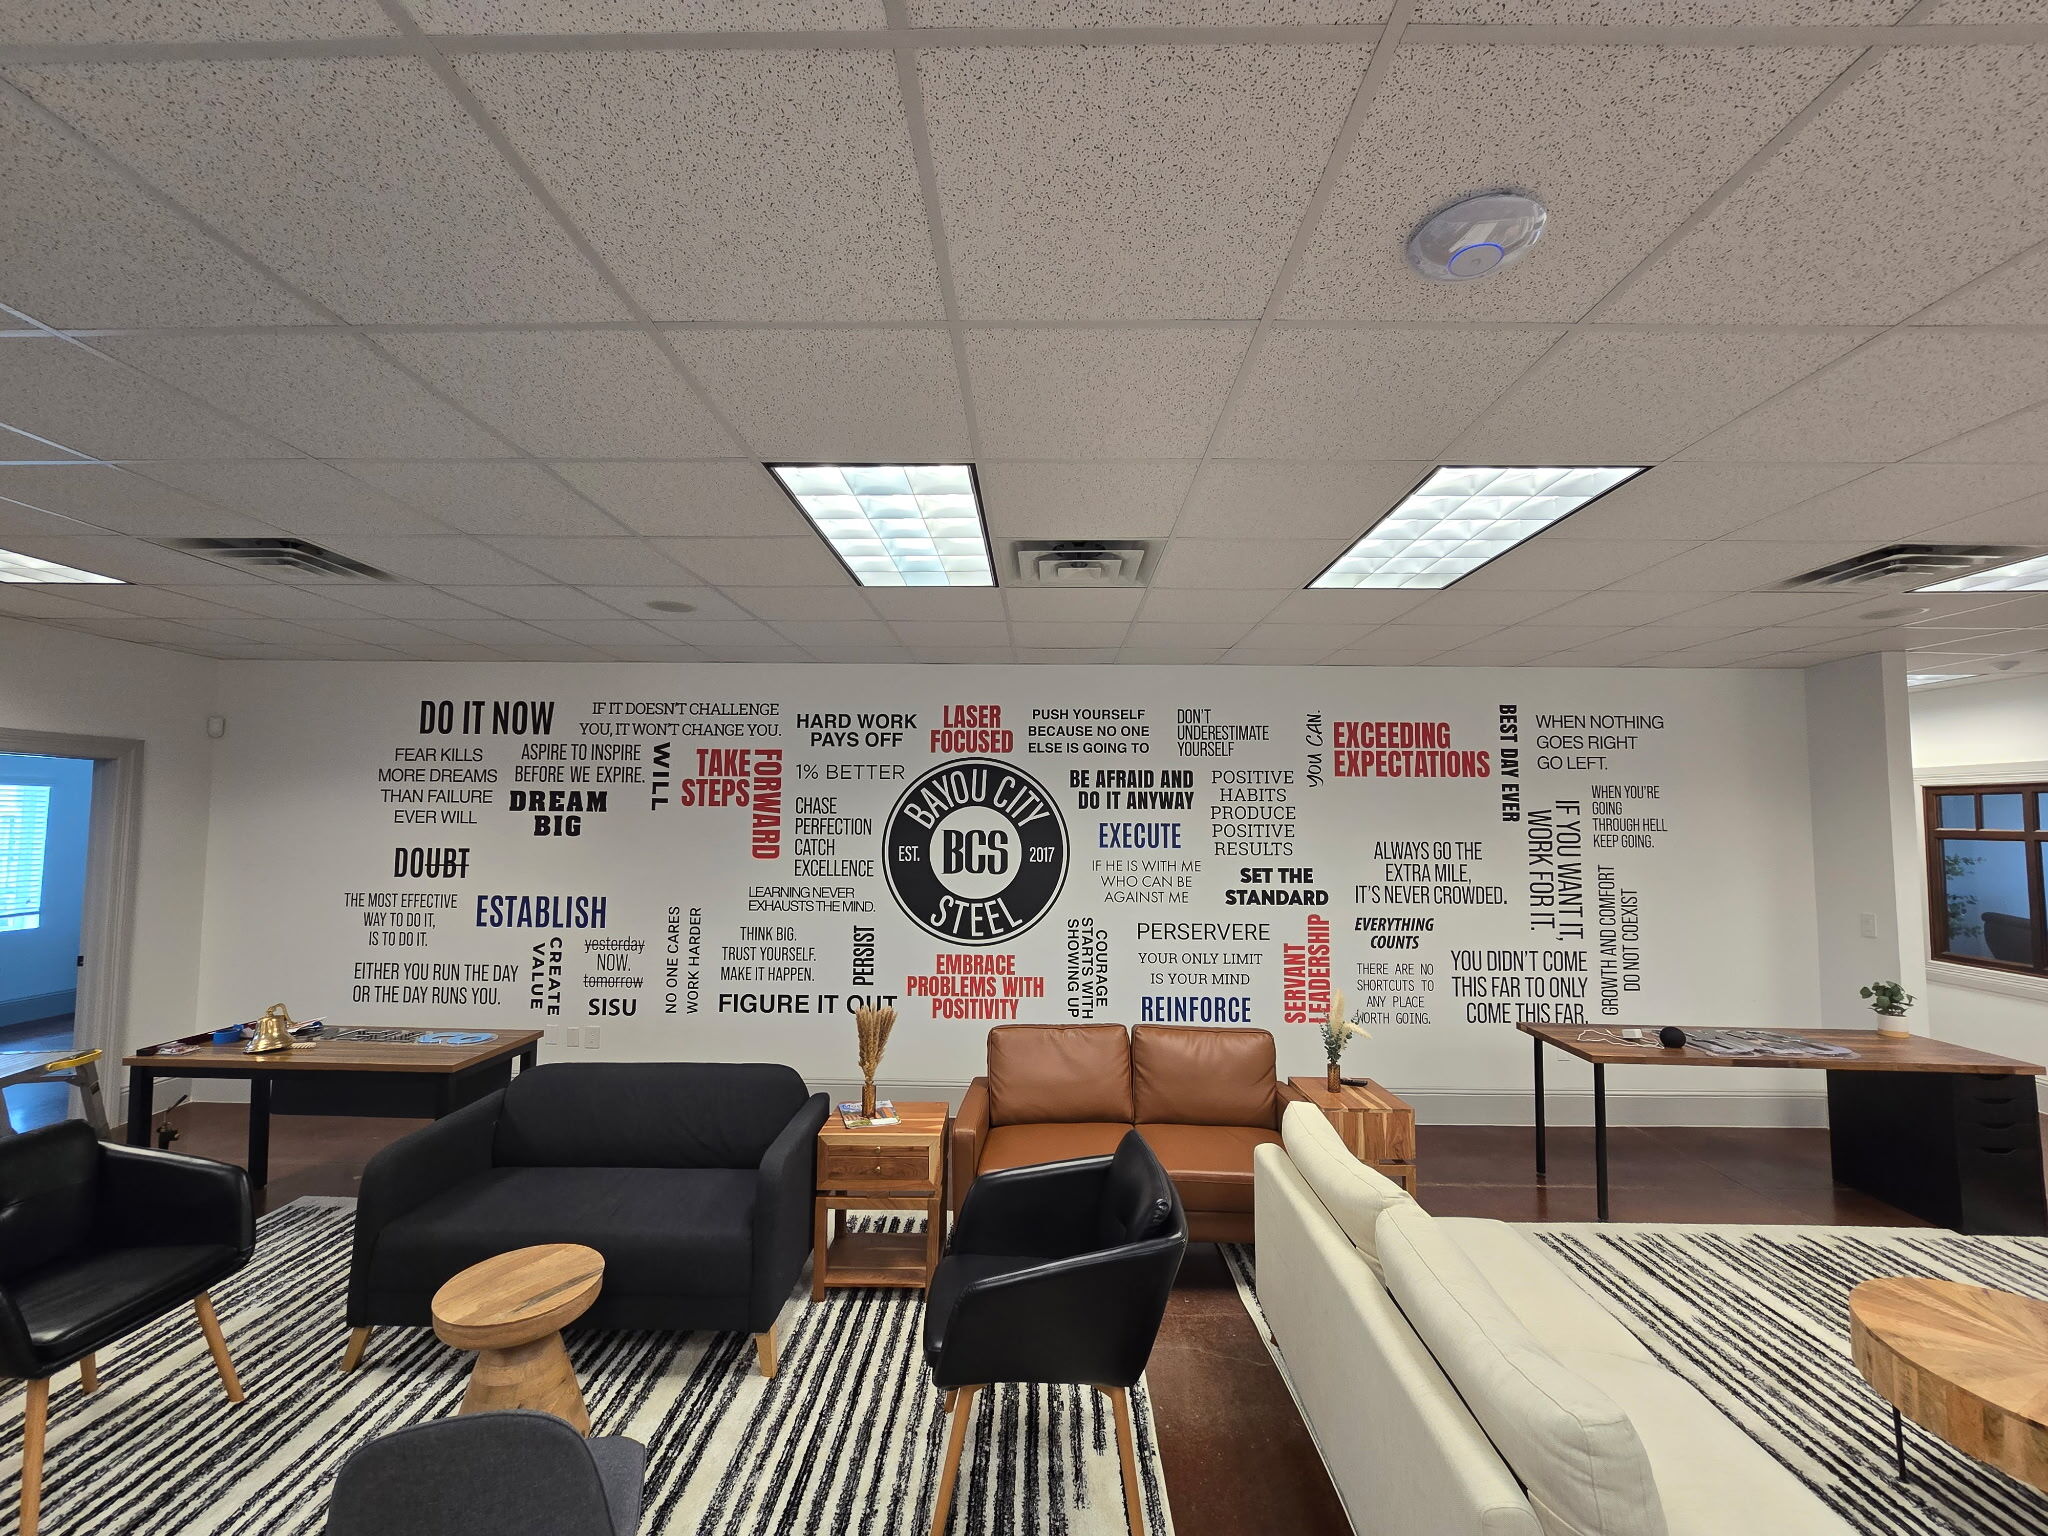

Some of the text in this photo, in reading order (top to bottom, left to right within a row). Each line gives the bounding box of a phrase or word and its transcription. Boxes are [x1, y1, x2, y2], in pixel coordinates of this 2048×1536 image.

[420, 700, 555, 735] DO IT NOW
[592, 702, 779, 716] IF IT DOESN'T CHALLENGE
[944, 705, 1001, 728] LASER
[1033, 709, 1145, 720] PUSH YOURSELF
[1177, 709, 1211, 724] DON'T
[797, 714, 917, 729] HARD WORK
[1535, 715, 1664, 729] WHEN NOTHING
[811, 732, 903, 747] PAYS OFF
[1028, 726, 1149, 736] BECAUSE NO ONE
[1177, 725, 1269, 740] UNDERESTIMATE
[1334, 722, 1451, 749] EXCEEDING
[931, 729, 1013, 753] FOCUSED
[1177, 741, 1235, 757] YOURSELF
[1537, 735, 1638, 749] GOES RIGHT
[395, 748, 483, 762] FEAR KILLS
[521, 743, 641, 761] ASPIRE TO INSPIRE
[696, 748, 751, 777] TAKE
[1334, 750, 1490, 778] EXPECTATIONS
[1499, 705, 1520, 822] BEST DAY EVER
[378, 768, 498, 783] MORE DREAMS
[515, 765, 645, 783] BEFORE WE EXPIRE.
[651, 742, 670, 811] WILL
[796, 764, 905, 780] 1% BETTER
[1070, 770, 1193, 788] BE AFRAID AND
[1211, 770, 1294, 784] POSITIVE
[380, 789, 493, 803] THAN FAILURE
[509, 790, 607, 812] DREAM
[681, 778, 750, 807] STEPS
[904, 769, 1051, 829] BAYOU CITY
[1078, 791, 1194, 810] DO IT ANYWAY
[1220, 788, 1286, 802] HABITS
[1591, 785, 1660, 799] WHEN YOU'RE
[752, 749, 783, 859] FORWARD
[796, 797, 837, 814] CHASE
[1210, 806, 1296, 820] PRODUCE
[1592, 801, 1622, 815] GOING
[394, 810, 477, 824] EVER WILL
[534, 815, 581, 837] BIG
[1592, 818, 1668, 832] THROUGH HELL
[795, 818, 872, 835] PERFECTION
[1099, 823, 1181, 848] EXECUTE
[1212, 824, 1295, 838] POSITIVE
[795, 838, 835, 856] CATCH
[1214, 842, 1293, 856] RESULTS
[1593, 834, 1654, 848] KEEP GOING.
[898, 846, 920, 862] EST.
[941, 829, 1009, 875] BCS
[1029, 847, 1055, 863] 2017
[1374, 841, 1482, 860] ALWAYS GO THE
[394, 847, 470, 878] DOUBT
[795, 859, 874, 877] EXCELLENCE
[1240, 867, 1313, 884] SET THE
[1386, 863, 1471, 885] EXTRA MILE,
[344, 893, 458, 908] THE MOST EFFECTIVE
[749, 886, 855, 898] LEARNING NEVER
[1104, 891, 1188, 903] AGAINST ME
[1225, 889, 1329, 906] STANDARD
[476, 895, 606, 928] ESTABLISH
[930, 896, 1023, 936] STEEL
[1138, 923, 1270, 940] PERSERVERE
[1355, 917, 1434, 931] EVERYTHING
[740, 926, 797, 941] THINK BIG.
[1371, 935, 1419, 949] COUNTS
[1597, 864, 1619, 1015] GROWTH AND COMFORT
[584, 936, 645, 955] yesterday
[722, 946, 816, 961] TRUST YOURSELF.
[597, 953, 631, 971] NOW.
[687, 908, 701, 1014] WORK HARDER
[853, 925, 874, 986] PERSIST
[936, 954, 1015, 975] EMBRACE
[1138, 952, 1263, 965] YOUR ONLY LIMIT
[1451, 950, 1588, 972] YOU DIDN'T COME
[354, 962, 519, 982] EITHER YOU RUN THE DAY
[530, 942, 545, 1009] VALUE
[547, 937, 562, 1015] CREATE
[1067, 919, 1079, 1017] SHOWING UP
[1082, 917, 1093, 1018] STARTS WITH
[1096, 930, 1108, 1007] COURAGE
[1307, 914, 1331, 1023] LEADERSHIP
[1357, 963, 1434, 975] THERE ARE NO
[583, 974, 644, 988] tomorrow
[907, 976, 1044, 997] PROBLEMS WITH
[1283, 943, 1306, 1023] SERVANT
[1357, 979, 1434, 991] SHORTCUTS TO
[1451, 976, 1588, 998] THIS FAR TO ONLY
[588, 998, 636, 1016] SISU
[932, 998, 1019, 1019] POSITIVITY
[1142, 996, 1251, 1022] REINFORCE
[1366, 996, 1424, 1008] ANY PLACE
